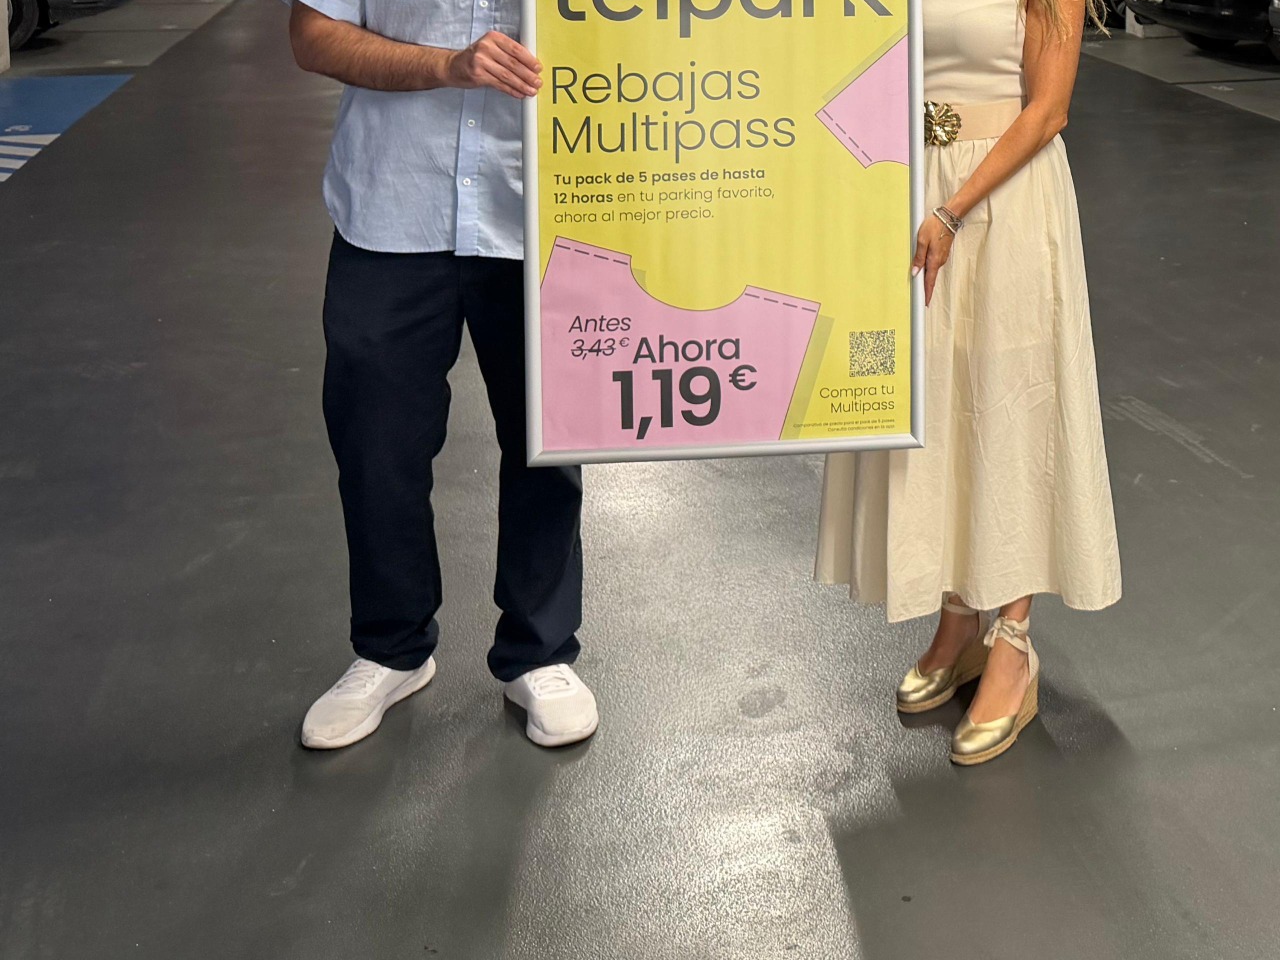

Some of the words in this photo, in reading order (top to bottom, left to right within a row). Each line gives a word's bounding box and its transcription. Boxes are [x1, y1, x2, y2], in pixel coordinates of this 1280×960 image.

[552, 61, 761, 114] Rebajas
[552, 111, 796, 163] Multipass
[554, 174, 571, 185] Tu
[575, 172, 612, 188] pack
[616, 172, 635, 184] de
[639, 171, 648, 183] 5
[652, 170, 696, 185] pases
[700, 169, 718, 181] de
[723, 168, 765, 180] hasta
[554, 192, 567, 204] 12
[571, 192, 613, 204] horas
[617, 192, 635, 202] en
[640, 190, 654, 202] tu
[659, 188, 713, 203] parking
[717, 186, 775, 200] favorito,
[554, 211, 597, 224] ahora
[602, 210, 615, 222] al
[619, 208, 660, 224] mejor
[665, 206, 715, 223] precio.
[568, 315, 632, 333] Antes
[633, 334, 741, 364] Ahora
[819, 387, 877, 400] Compra
[881, 384, 895, 395] tu
[830, 400, 895, 415] Multipass
